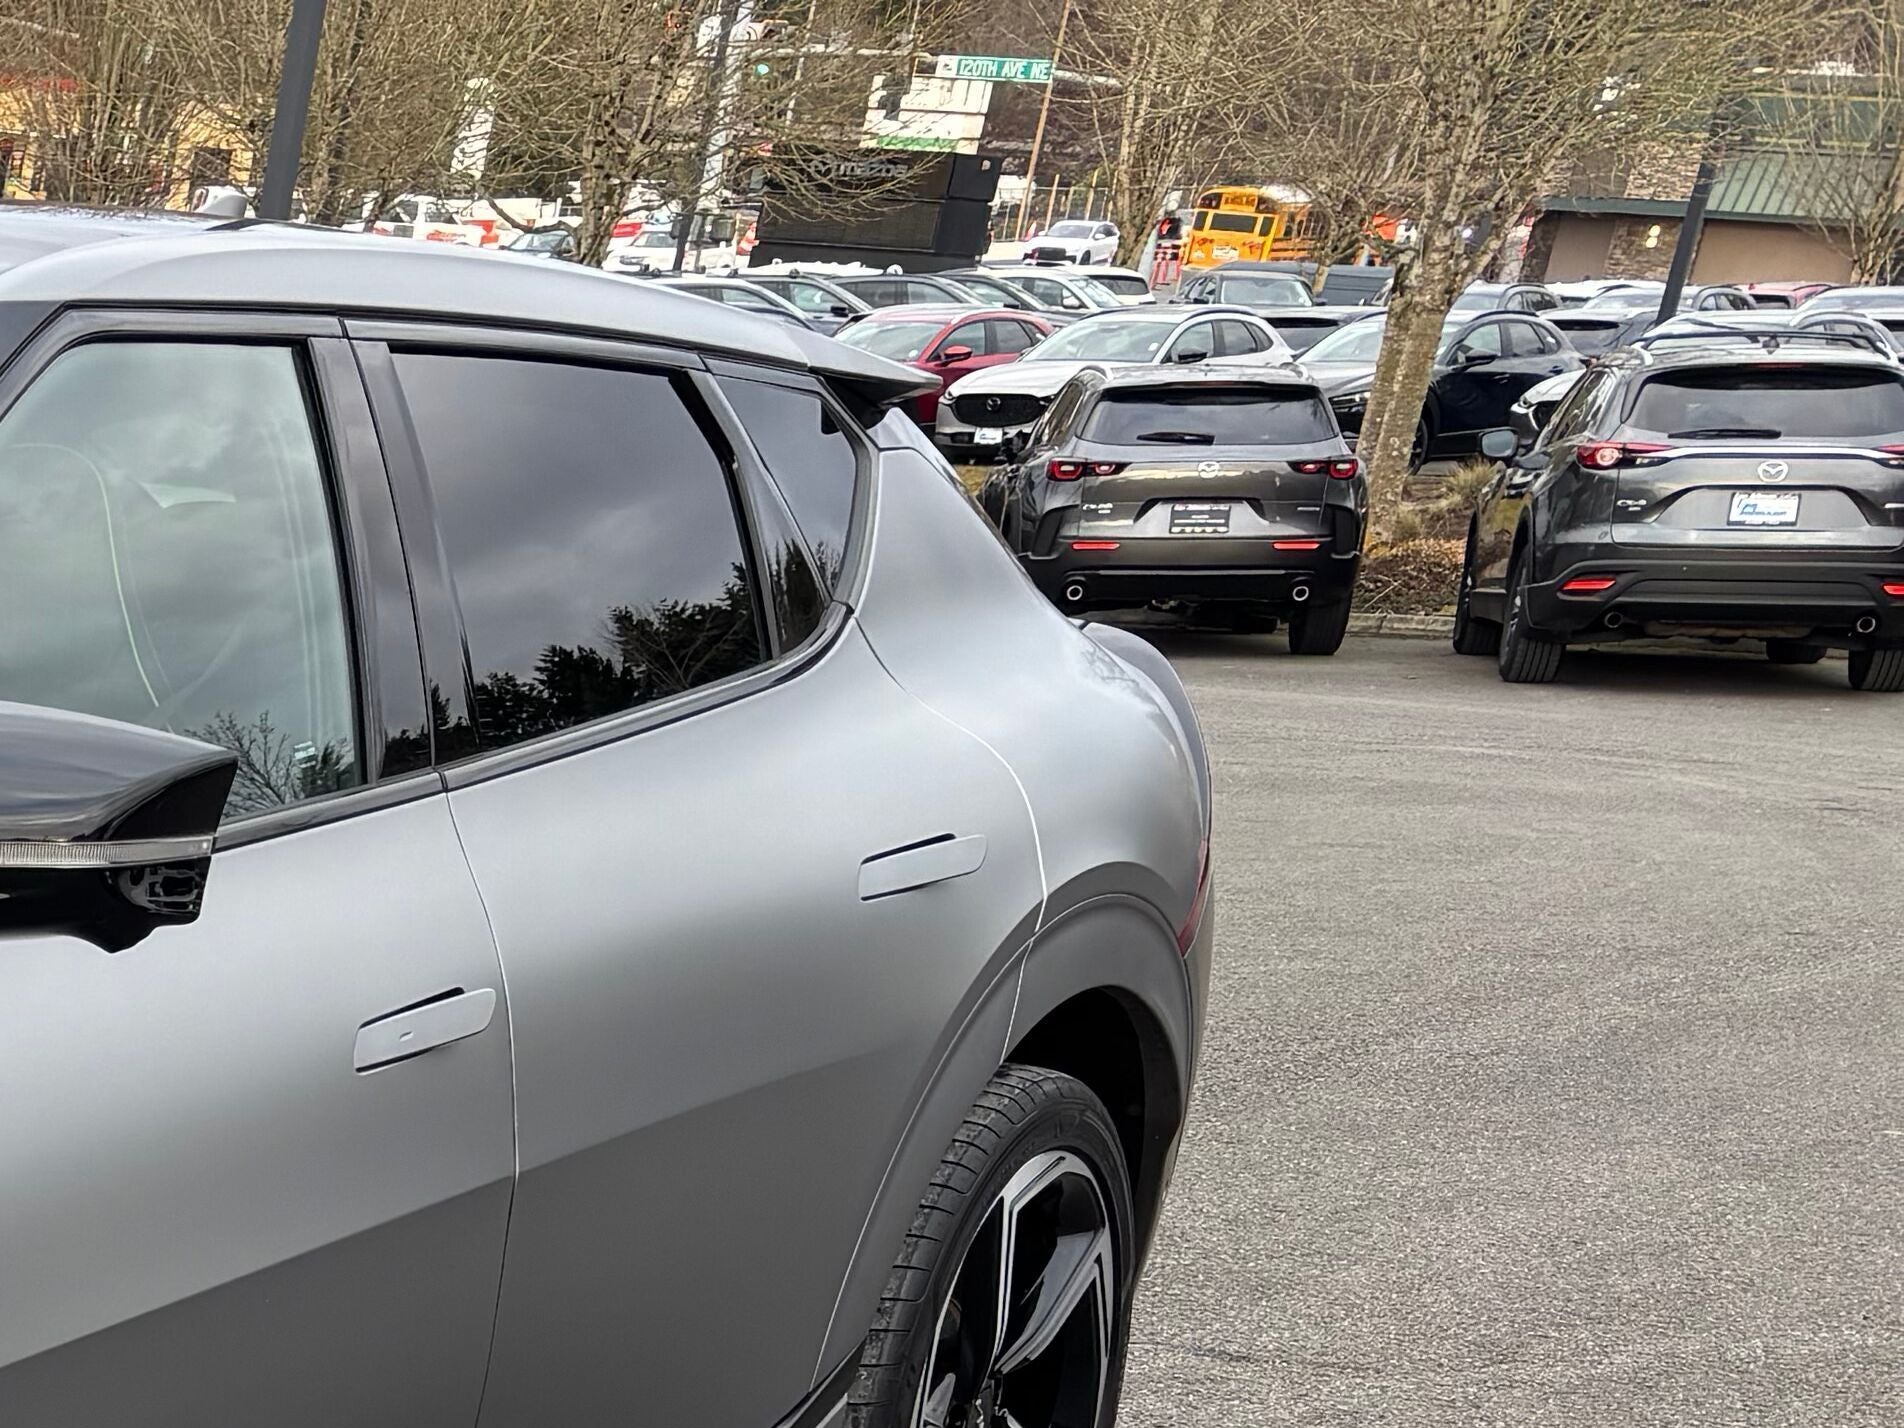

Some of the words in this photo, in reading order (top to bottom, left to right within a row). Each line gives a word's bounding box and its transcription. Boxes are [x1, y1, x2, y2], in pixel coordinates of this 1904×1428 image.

[959, 61, 998, 77] 120TH
[1001, 61, 1027, 78] AVE
[1030, 62, 1051, 80] NE
